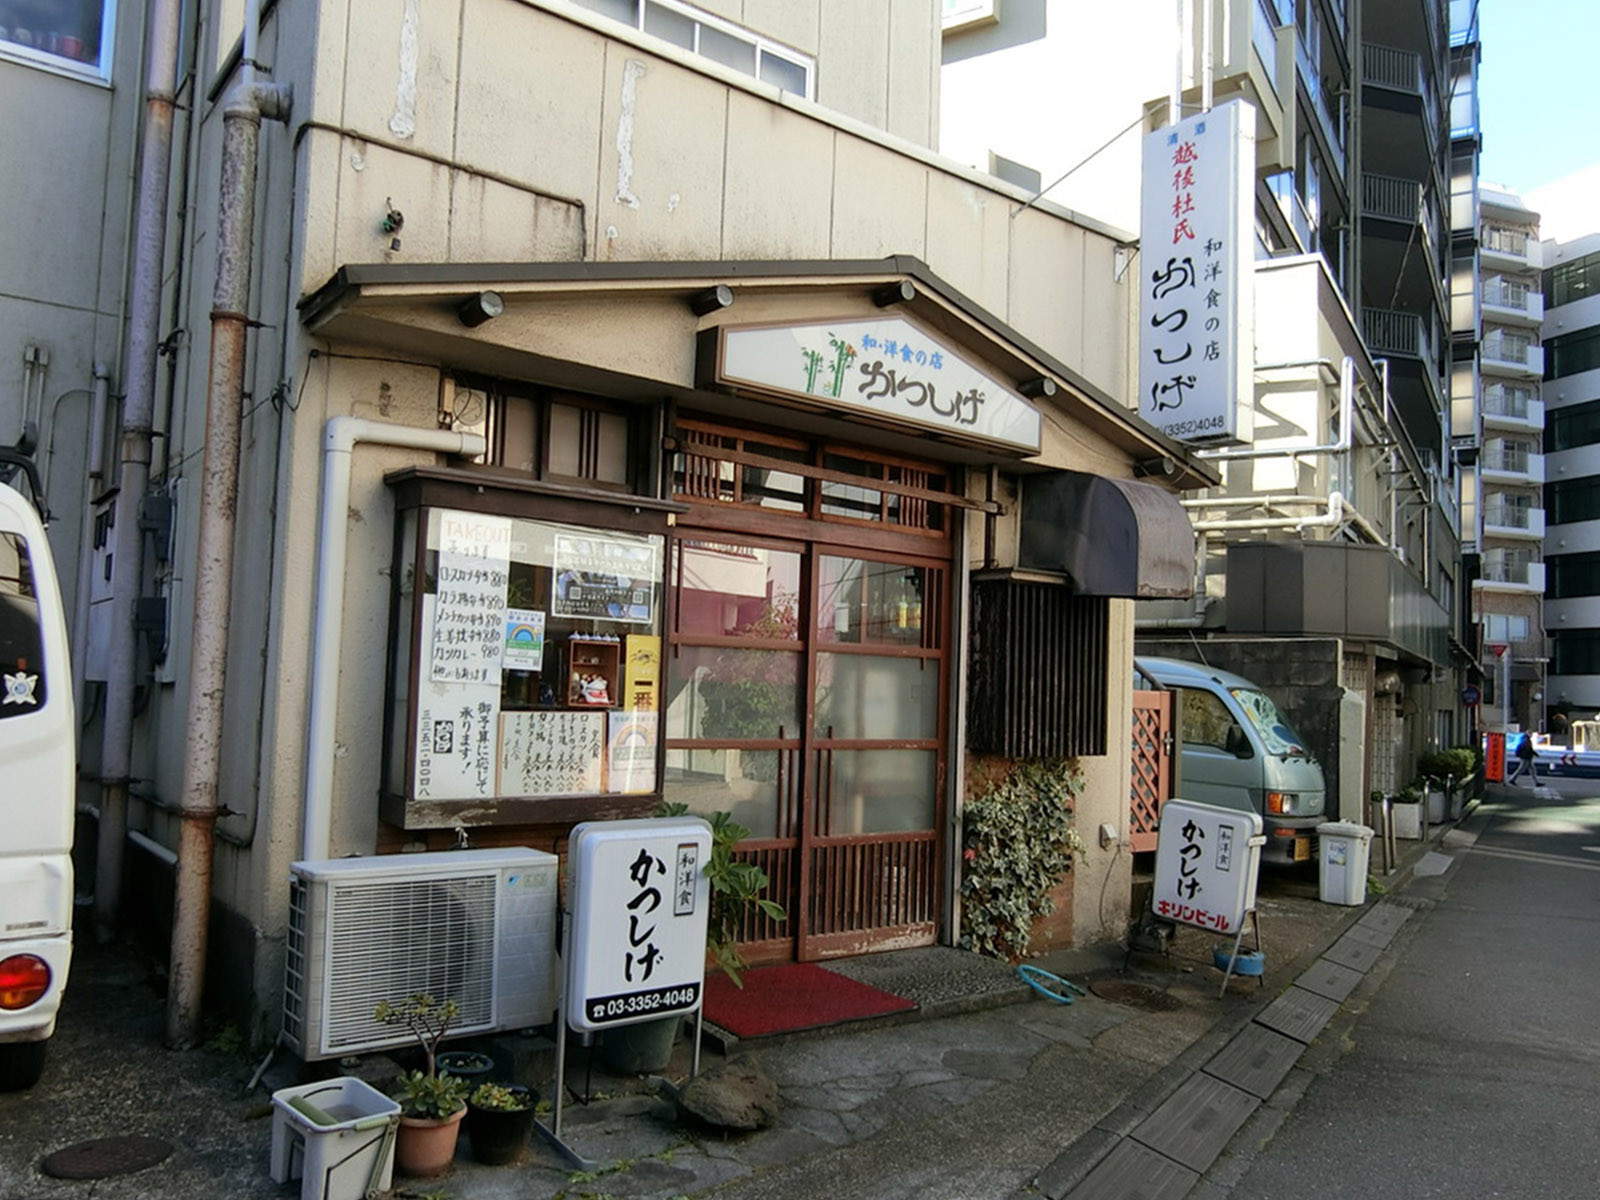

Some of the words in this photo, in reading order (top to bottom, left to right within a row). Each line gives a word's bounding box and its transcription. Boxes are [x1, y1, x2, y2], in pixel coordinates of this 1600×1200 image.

[1171, 141, 1198, 245] 越後杜氏
[1151, 256, 1197, 412] かつしげ
[1202, 237, 1223, 362] 和洋食の店
[858, 360, 986, 425] かつしげ
[678, 852, 695, 906] 和洋食
[1176, 819, 1206, 900] かつしげ
[624, 847, 667, 983] かつしげ
[1158, 900, 1229, 930] キリンビール
[607, 987, 694, 1017] 03-3352-4048
